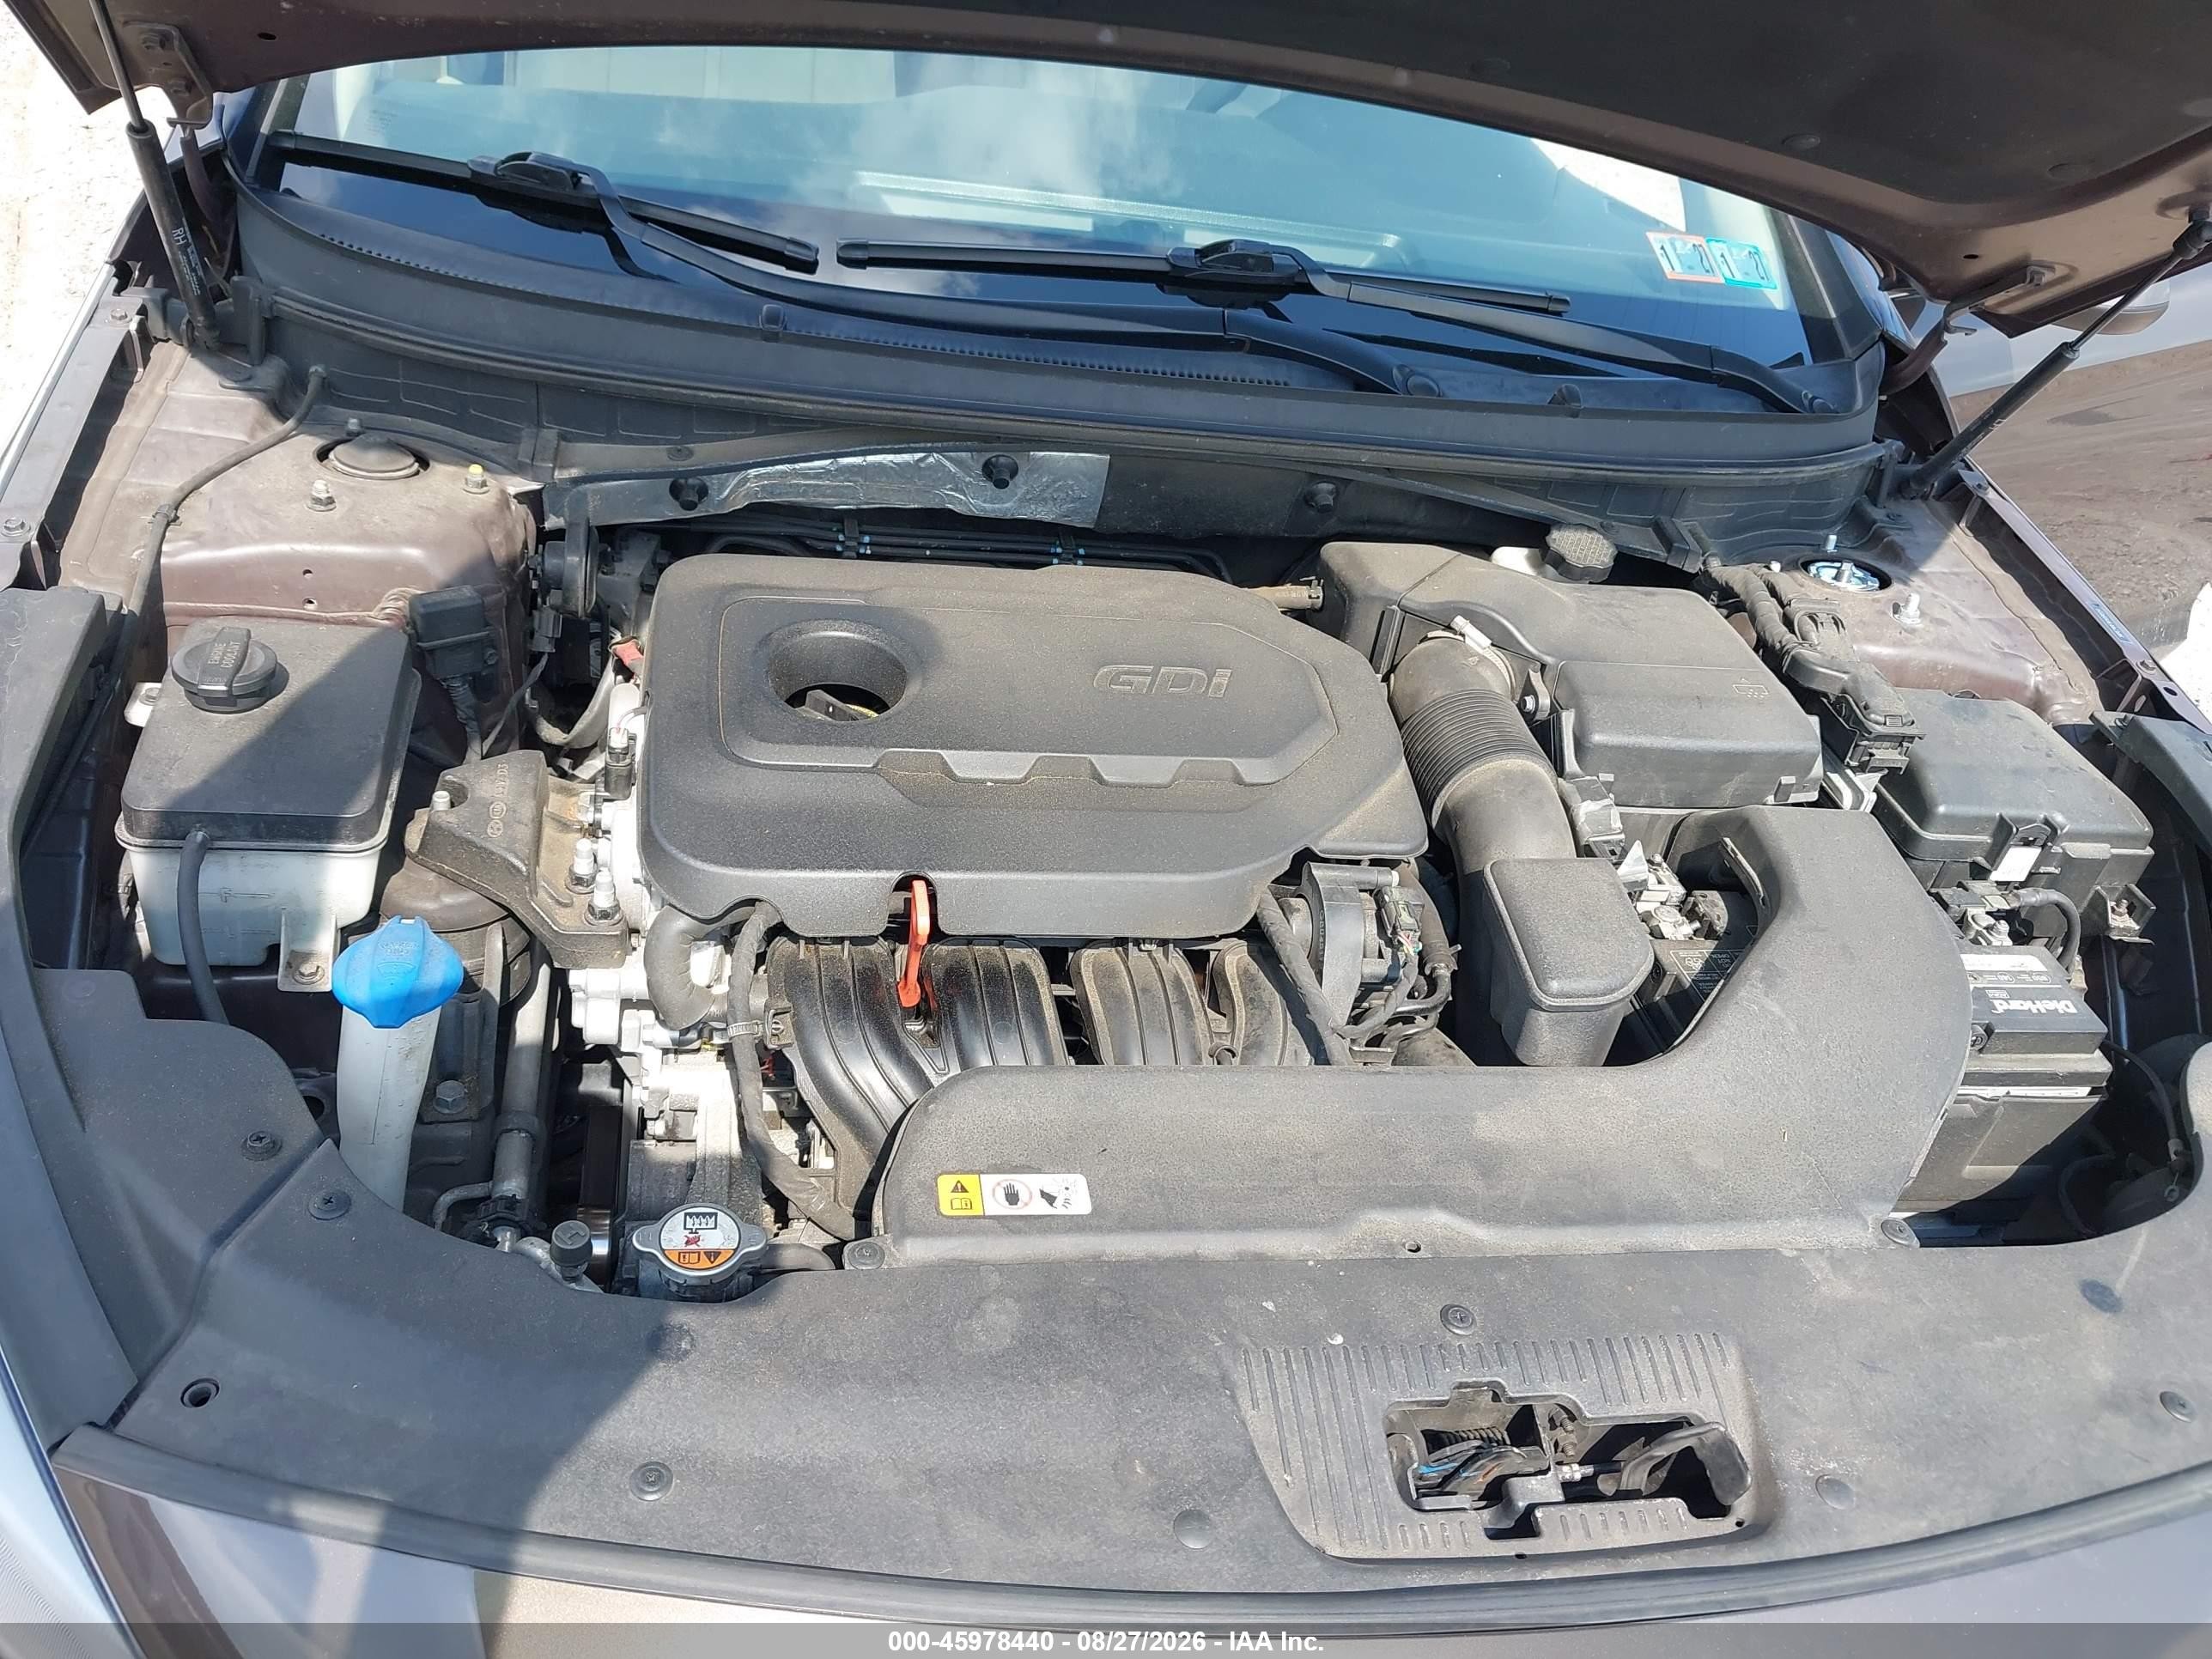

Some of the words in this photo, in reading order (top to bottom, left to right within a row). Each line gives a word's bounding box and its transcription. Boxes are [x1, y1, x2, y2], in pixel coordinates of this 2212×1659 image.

[172, 227, 187, 246] RH
[207, 642, 227, 665] ENGINE
[1093, 664, 1232, 698] GDi
[1990, 999, 2078, 1014] DieHard
